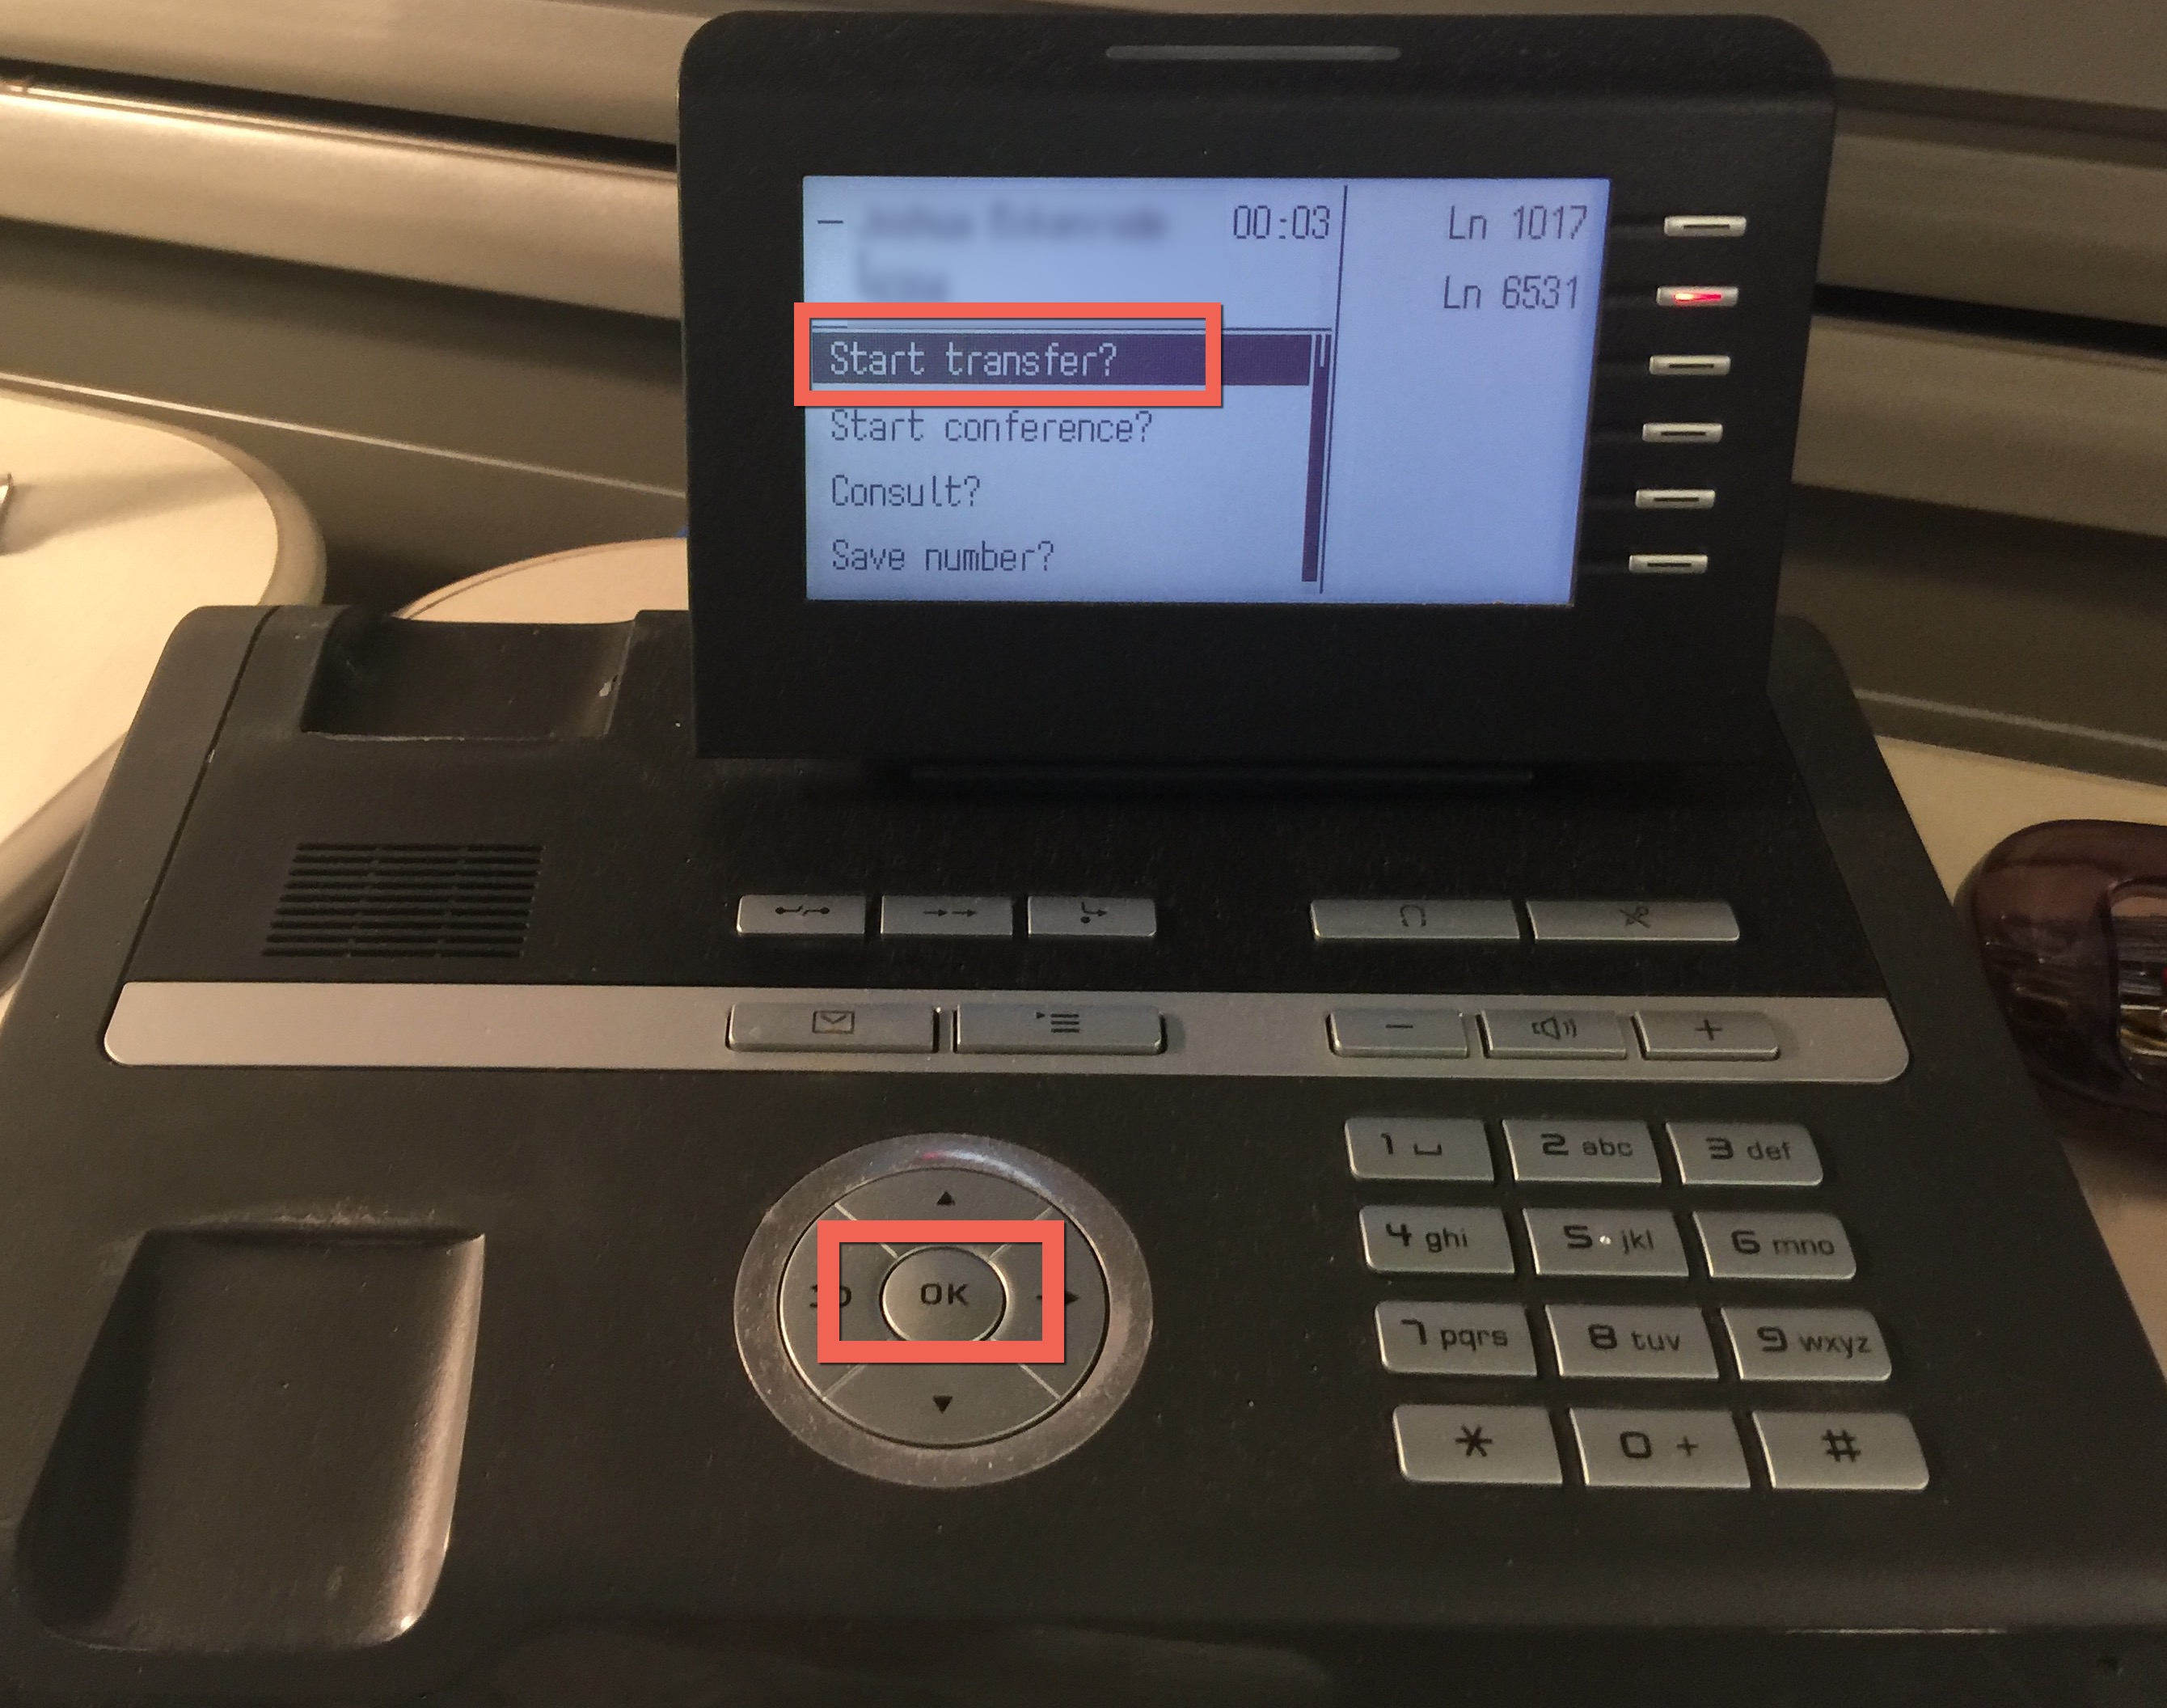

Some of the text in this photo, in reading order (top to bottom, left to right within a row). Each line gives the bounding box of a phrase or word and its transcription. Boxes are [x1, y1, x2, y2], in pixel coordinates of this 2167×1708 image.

[1233, 205, 1331, 240] 00:03
[1448, 205, 1588, 240] Ln 1017
[1443, 275, 1578, 310] Ln 6531
[830, 340, 1117, 377] Start transfer?
[831, 408, 1153, 443] Start conference?
[831, 474, 981, 507] Consult?
[832, 539, 1054, 572] Save number?
[1380, 1133, 1394, 1155] 1
[1540, 1133, 1633, 1157] 2 abc
[1705, 1136, 1791, 1161] 3 def
[1385, 1223, 1468, 1254] 4 ghi
[1563, 1224, 1654, 1255] 5 jkl
[1730, 1229, 1835, 1256] 6 mno
[920, 1283, 969, 1307] OK
[1400, 1319, 1509, 1352] 7 pqrs
[1587, 1323, 1680, 1351] 8 tuv
[1756, 1325, 1871, 1359] 9 wxyz
[1619, 1431, 1653, 1460] 0
